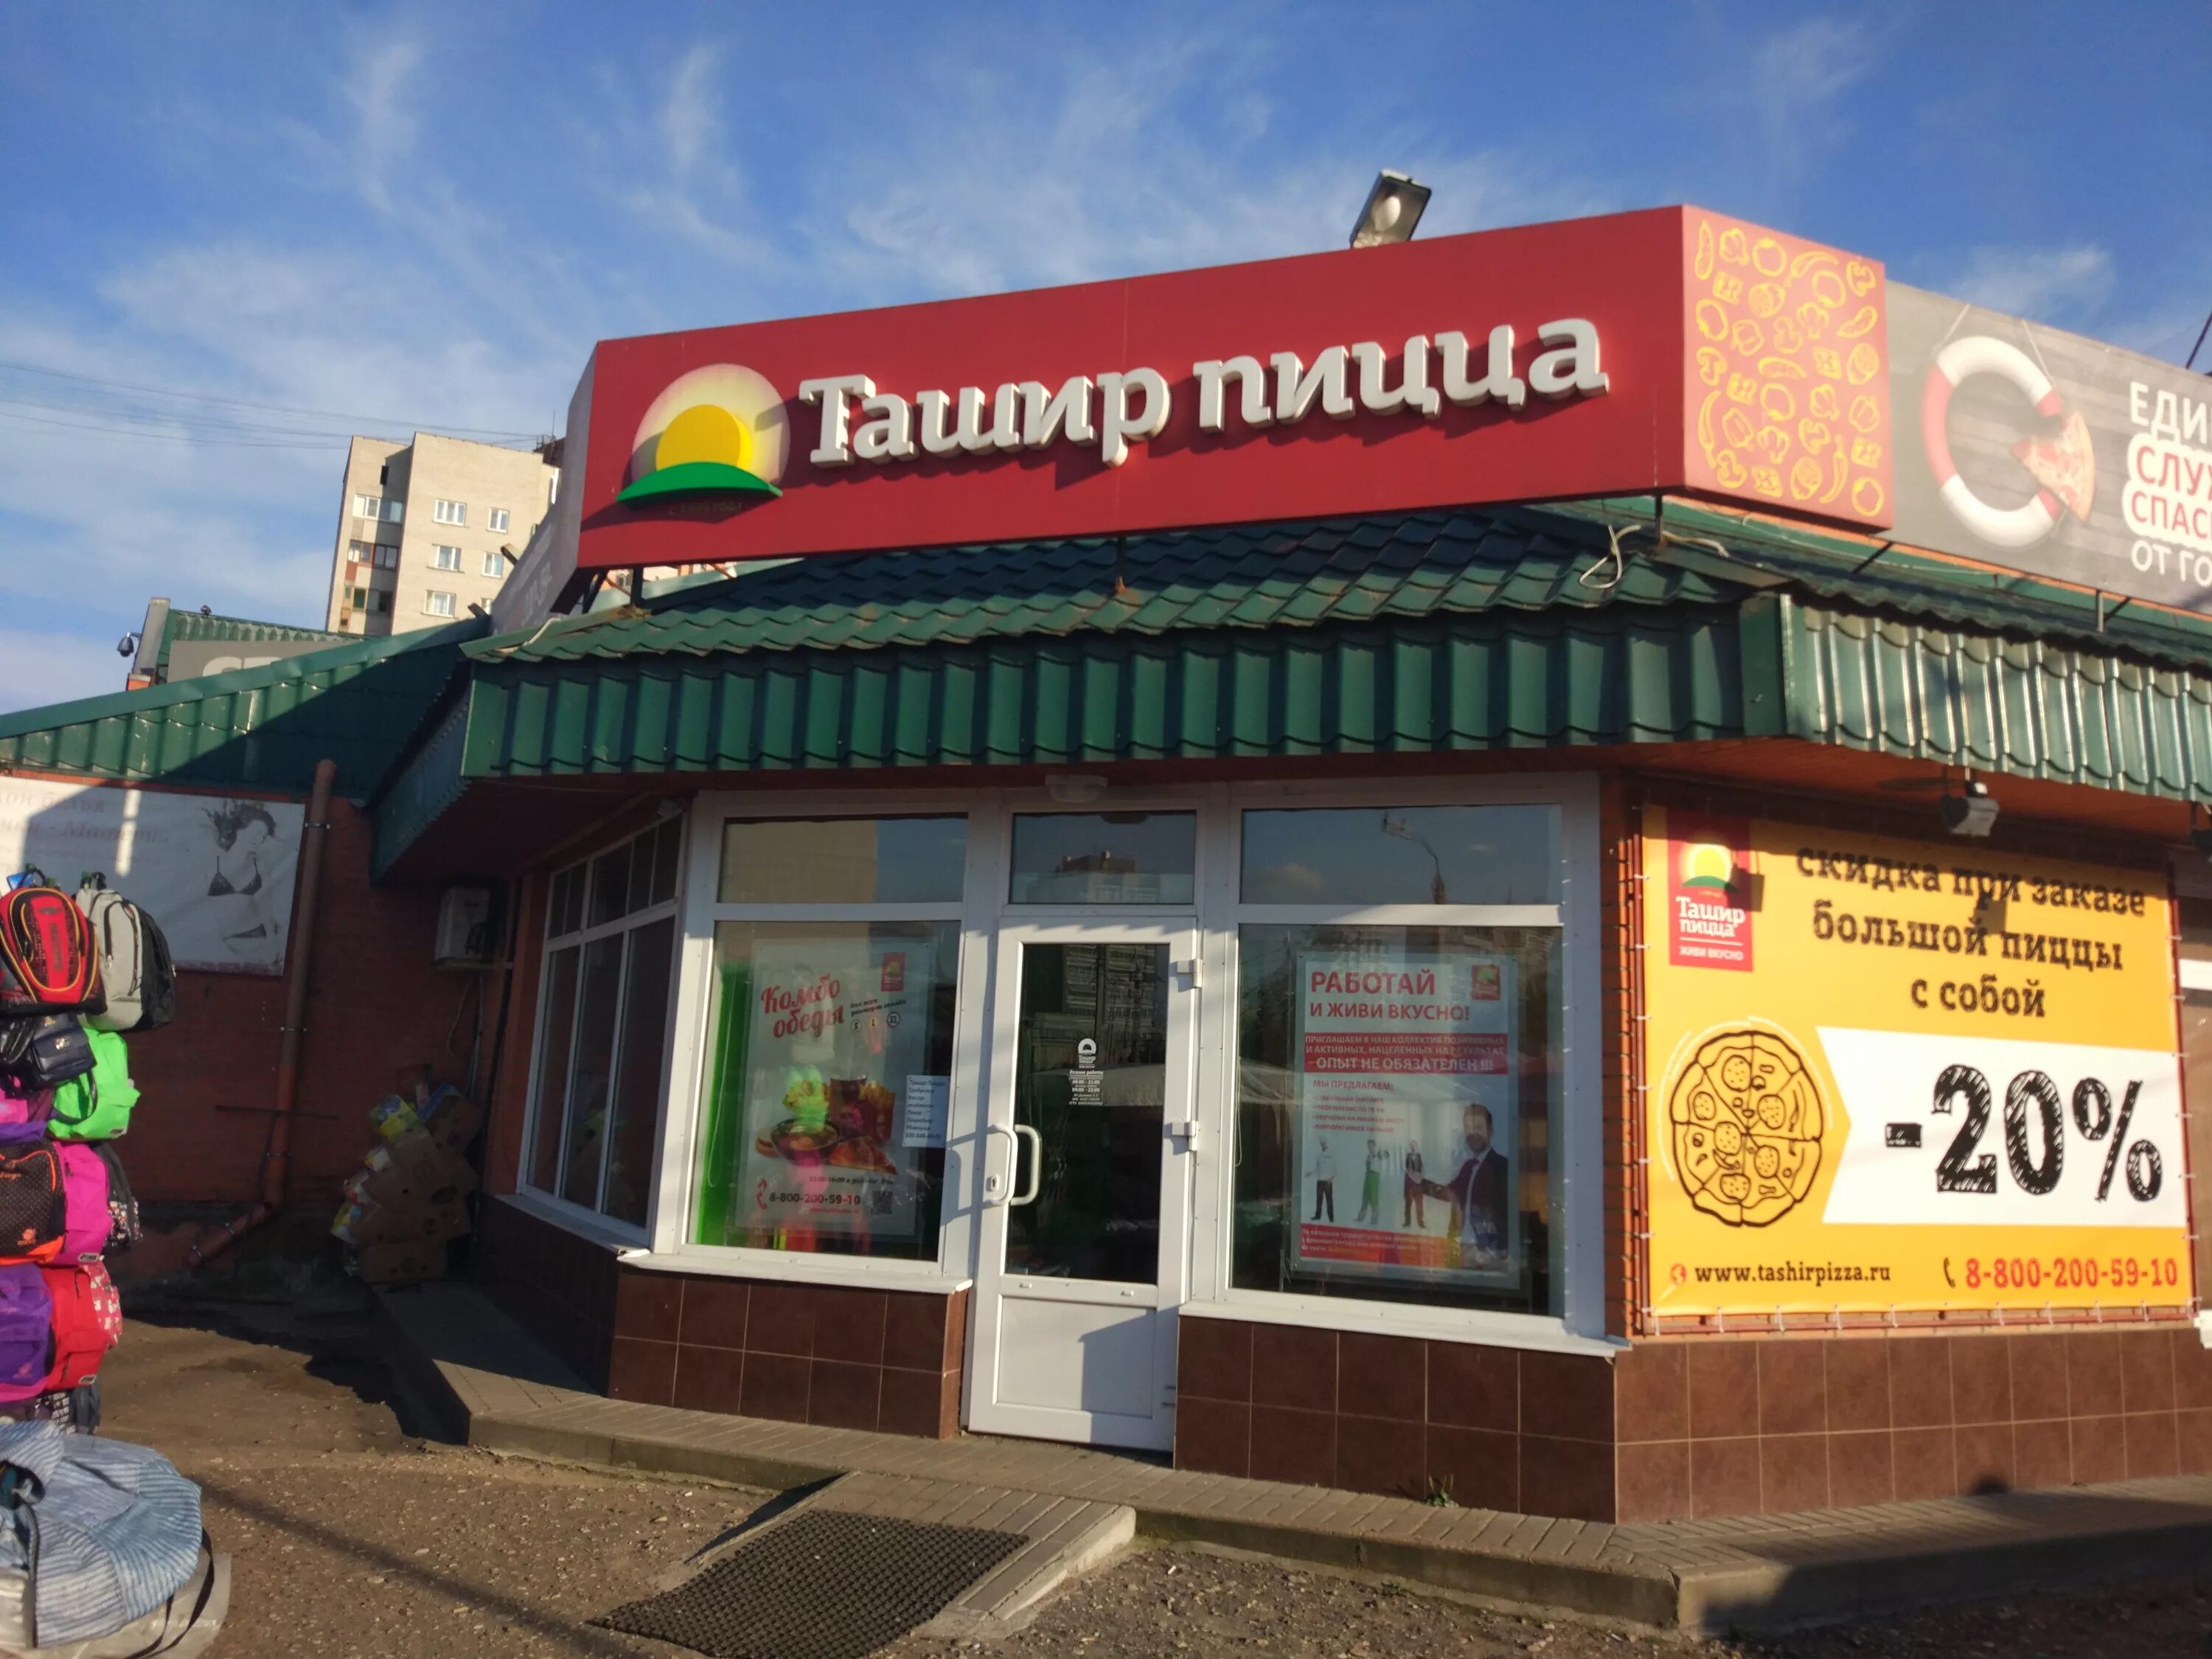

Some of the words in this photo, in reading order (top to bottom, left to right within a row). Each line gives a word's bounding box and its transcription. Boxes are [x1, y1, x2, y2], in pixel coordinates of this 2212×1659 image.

[799, 366, 1171, 467] Ташир
[1194, 318, 1610, 433] пицца
[2129, 380, 2212, 445] ЕДИ
[2131, 490, 2212, 540] СПАС
[2132, 540, 2171, 575] ОТ
[1796, 847, 1941, 892] скидка
[1951, 867, 2021, 911] при
[2031, 876, 2146, 917] заказе
[1675, 896, 1746, 928] Ташир
[1679, 919, 1736, 938] пицца
[1813, 899, 1988, 957] большой
[2000, 931, 2123, 972] пиццы
[760, 973, 841, 1015] Комбо
[1310, 968, 1436, 995] РАБОТАЙ
[1911, 978, 1928, 1009] с
[1940, 974, 2045, 1018] собой
[773, 1005, 845, 1038] обеды
[1310, 1002, 1322, 1017] И
[1327, 1002, 1383, 1018] ЖИВИ
[1388, 1004, 1470, 1020] ВКУСНО!
[1305, 1035, 1362, 1044] ПРИГЛАШАЕМ
[1371, 1036, 1391, 1044] НАШ
[1316, 1057, 1358, 1069] ОПЫТ
[1361, 1057, 1379, 1069] НЕ
[1382, 1057, 1476, 1071] ОБЯЗАТЕЛЕН
[1885, 1063, 2163, 1203] -20%
[769, 1192, 861, 1206] 8-800-200-59-10
[1696, 1262, 1891, 1287] www.tashirpizza.ru
[1966, 1257, 2178, 1289] 8-800-200-59-10
